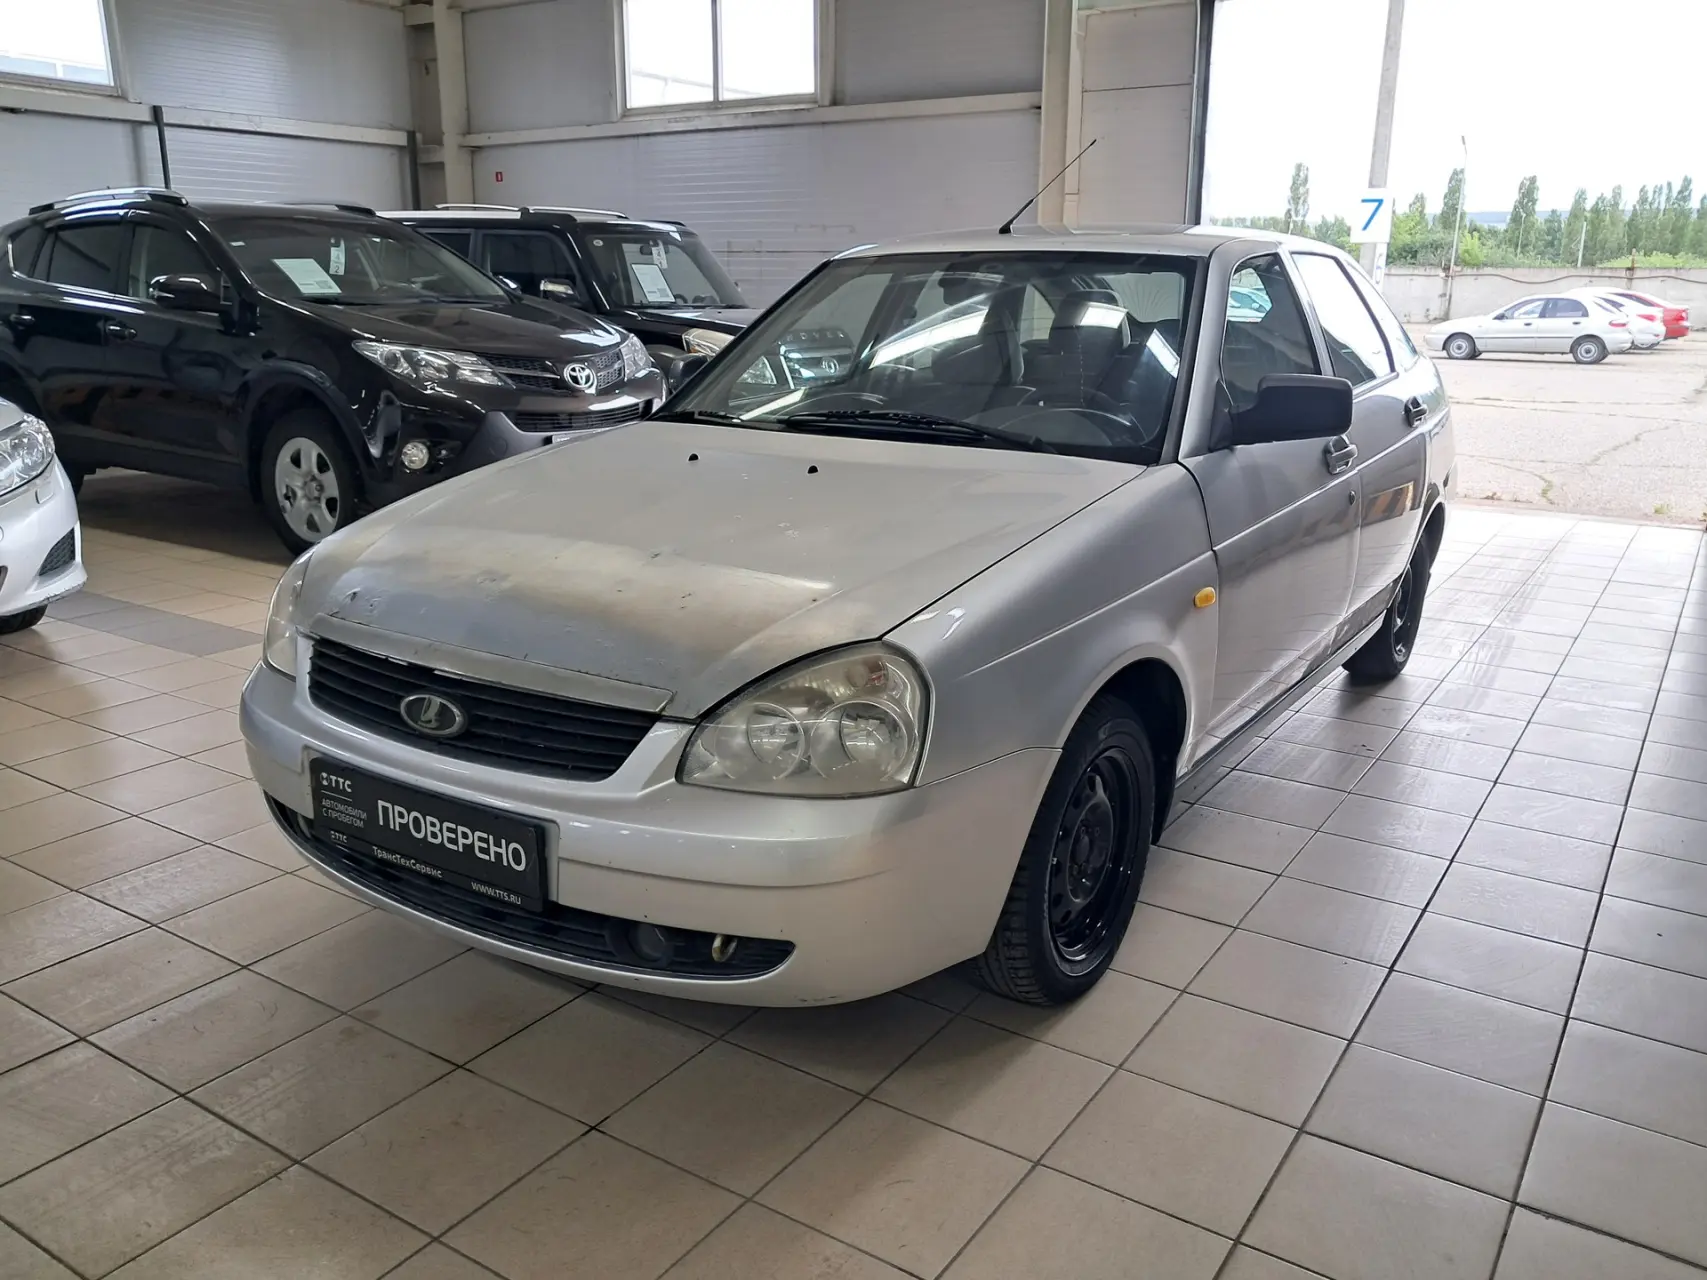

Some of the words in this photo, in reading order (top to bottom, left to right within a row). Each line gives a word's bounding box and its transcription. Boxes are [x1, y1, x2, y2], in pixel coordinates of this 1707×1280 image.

[1361, 198, 1384, 231] 7
[322, 798, 367, 821] АВТОМОБИЛИ
[322, 807, 328, 817] С
[328, 809, 364, 829] ПРОБЕГОМ
[377, 799, 526, 872] ПРОВЕРЕНО
[372, 846, 442, 878] ТрансТехСервис
[471, 881, 521, 906] WWW.TTS.RU
